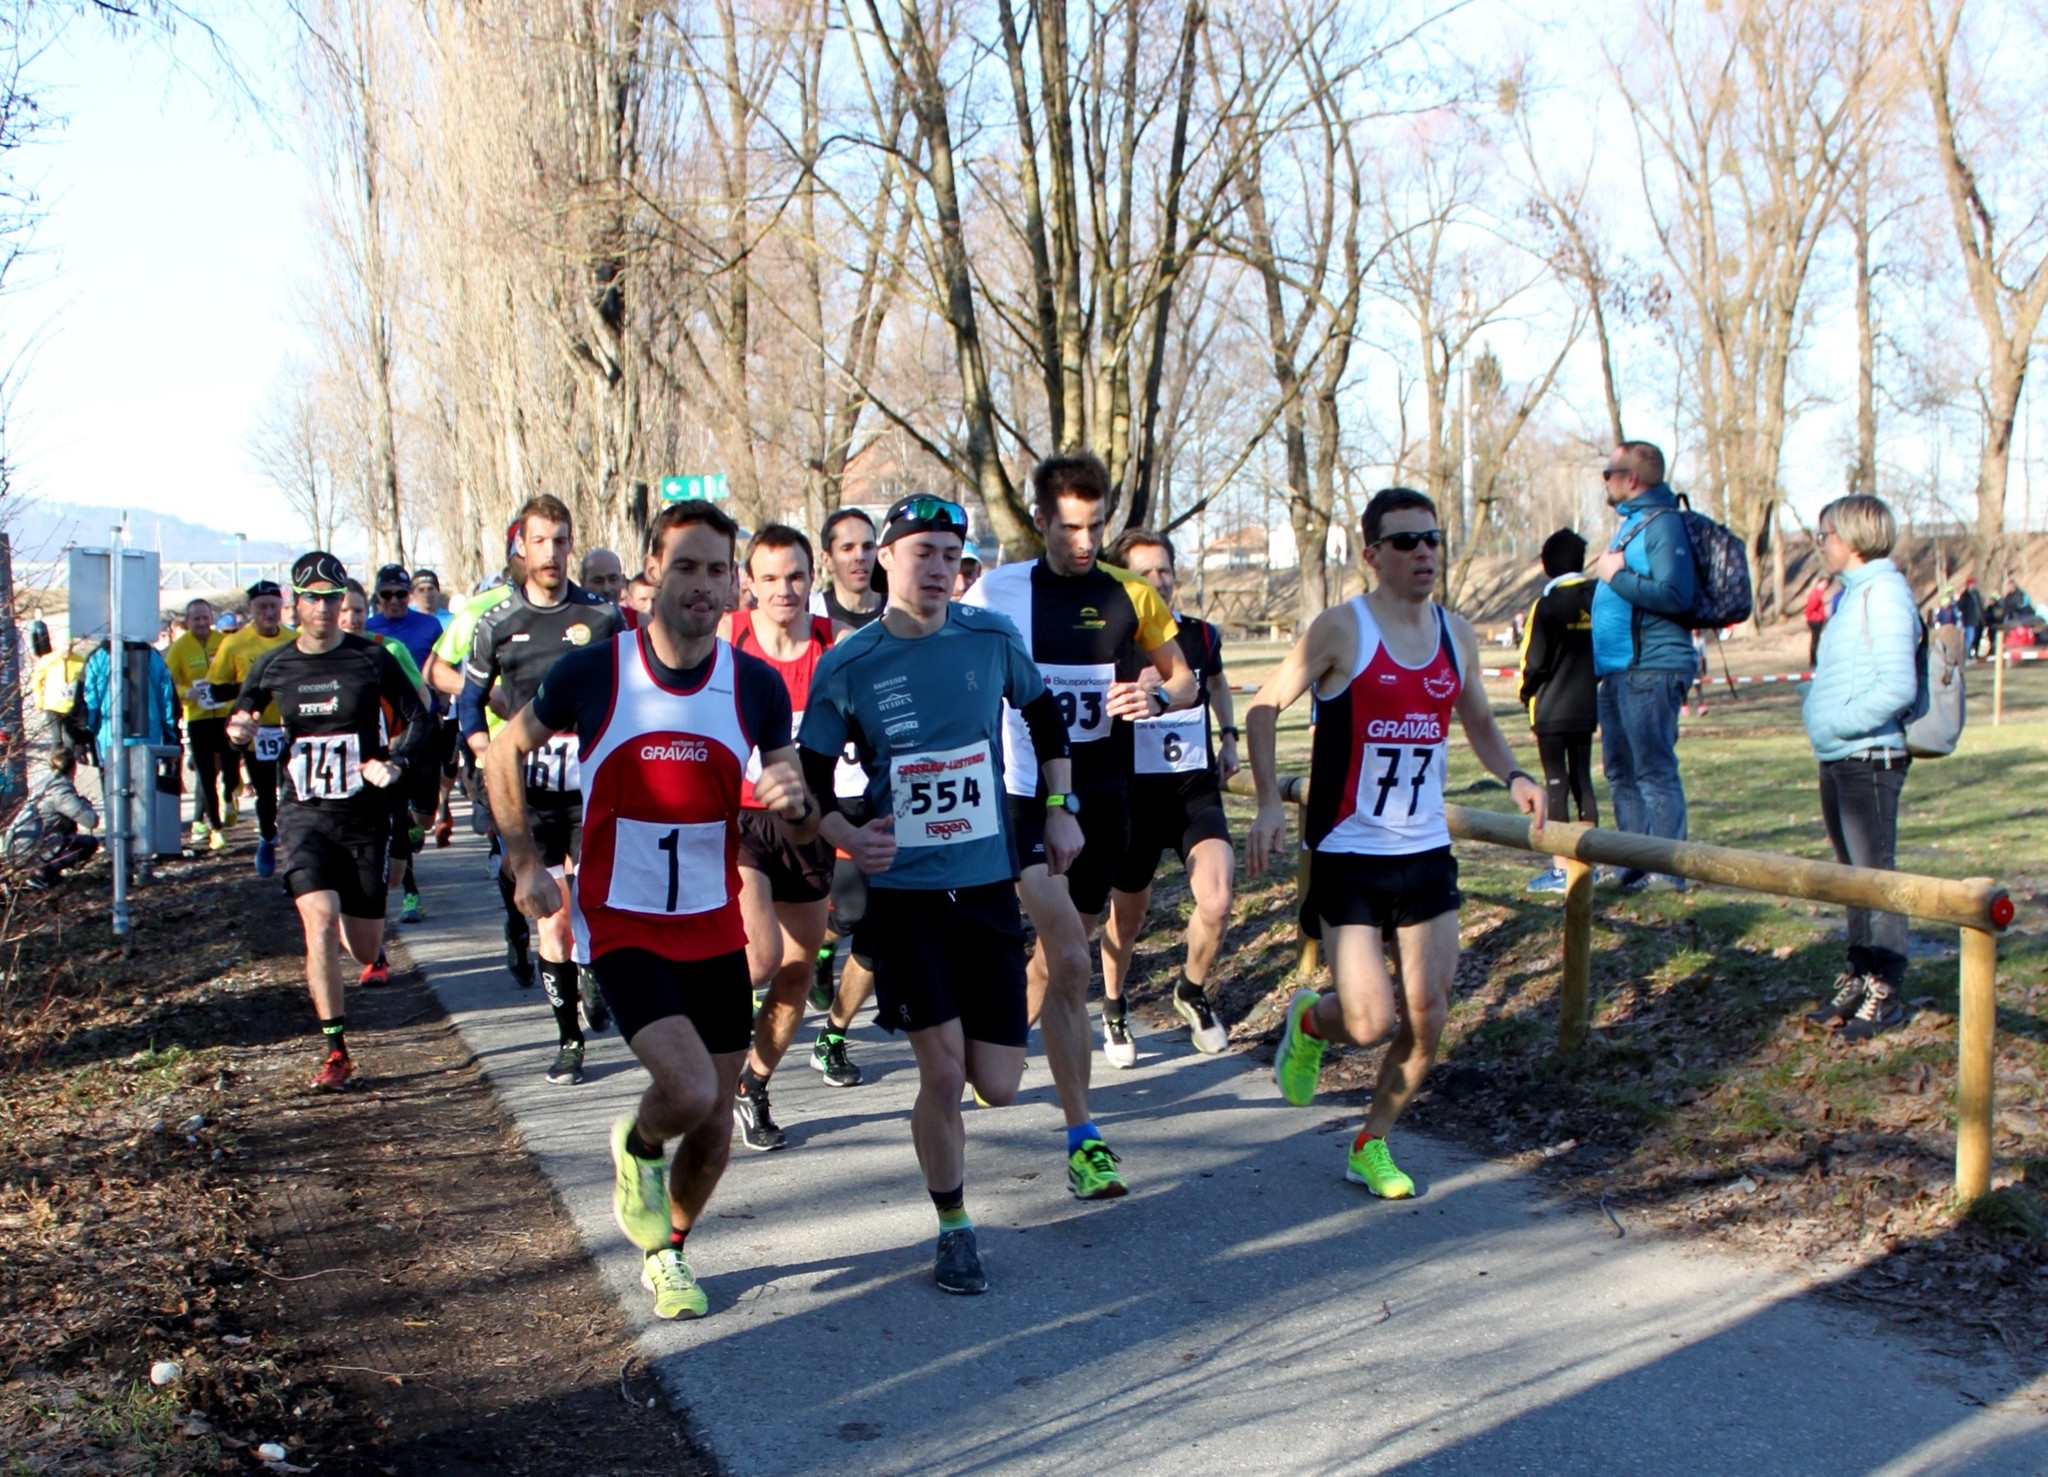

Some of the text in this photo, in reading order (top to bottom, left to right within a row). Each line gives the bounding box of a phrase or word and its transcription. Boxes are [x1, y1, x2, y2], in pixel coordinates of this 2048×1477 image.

[879, 697, 913, 711] HEIDEN
[1367, 719, 1441, 739] GRAVAG
[259, 737, 285, 756] 19
[640, 746, 709, 761] GRAVAG
[1164, 732, 1182, 762] 6
[300, 740, 348, 794] 141
[1373, 747, 1434, 817] 77
[911, 776, 981, 816] 554
[925, 818, 973, 841] hagen
[658, 828, 680, 913] 1
